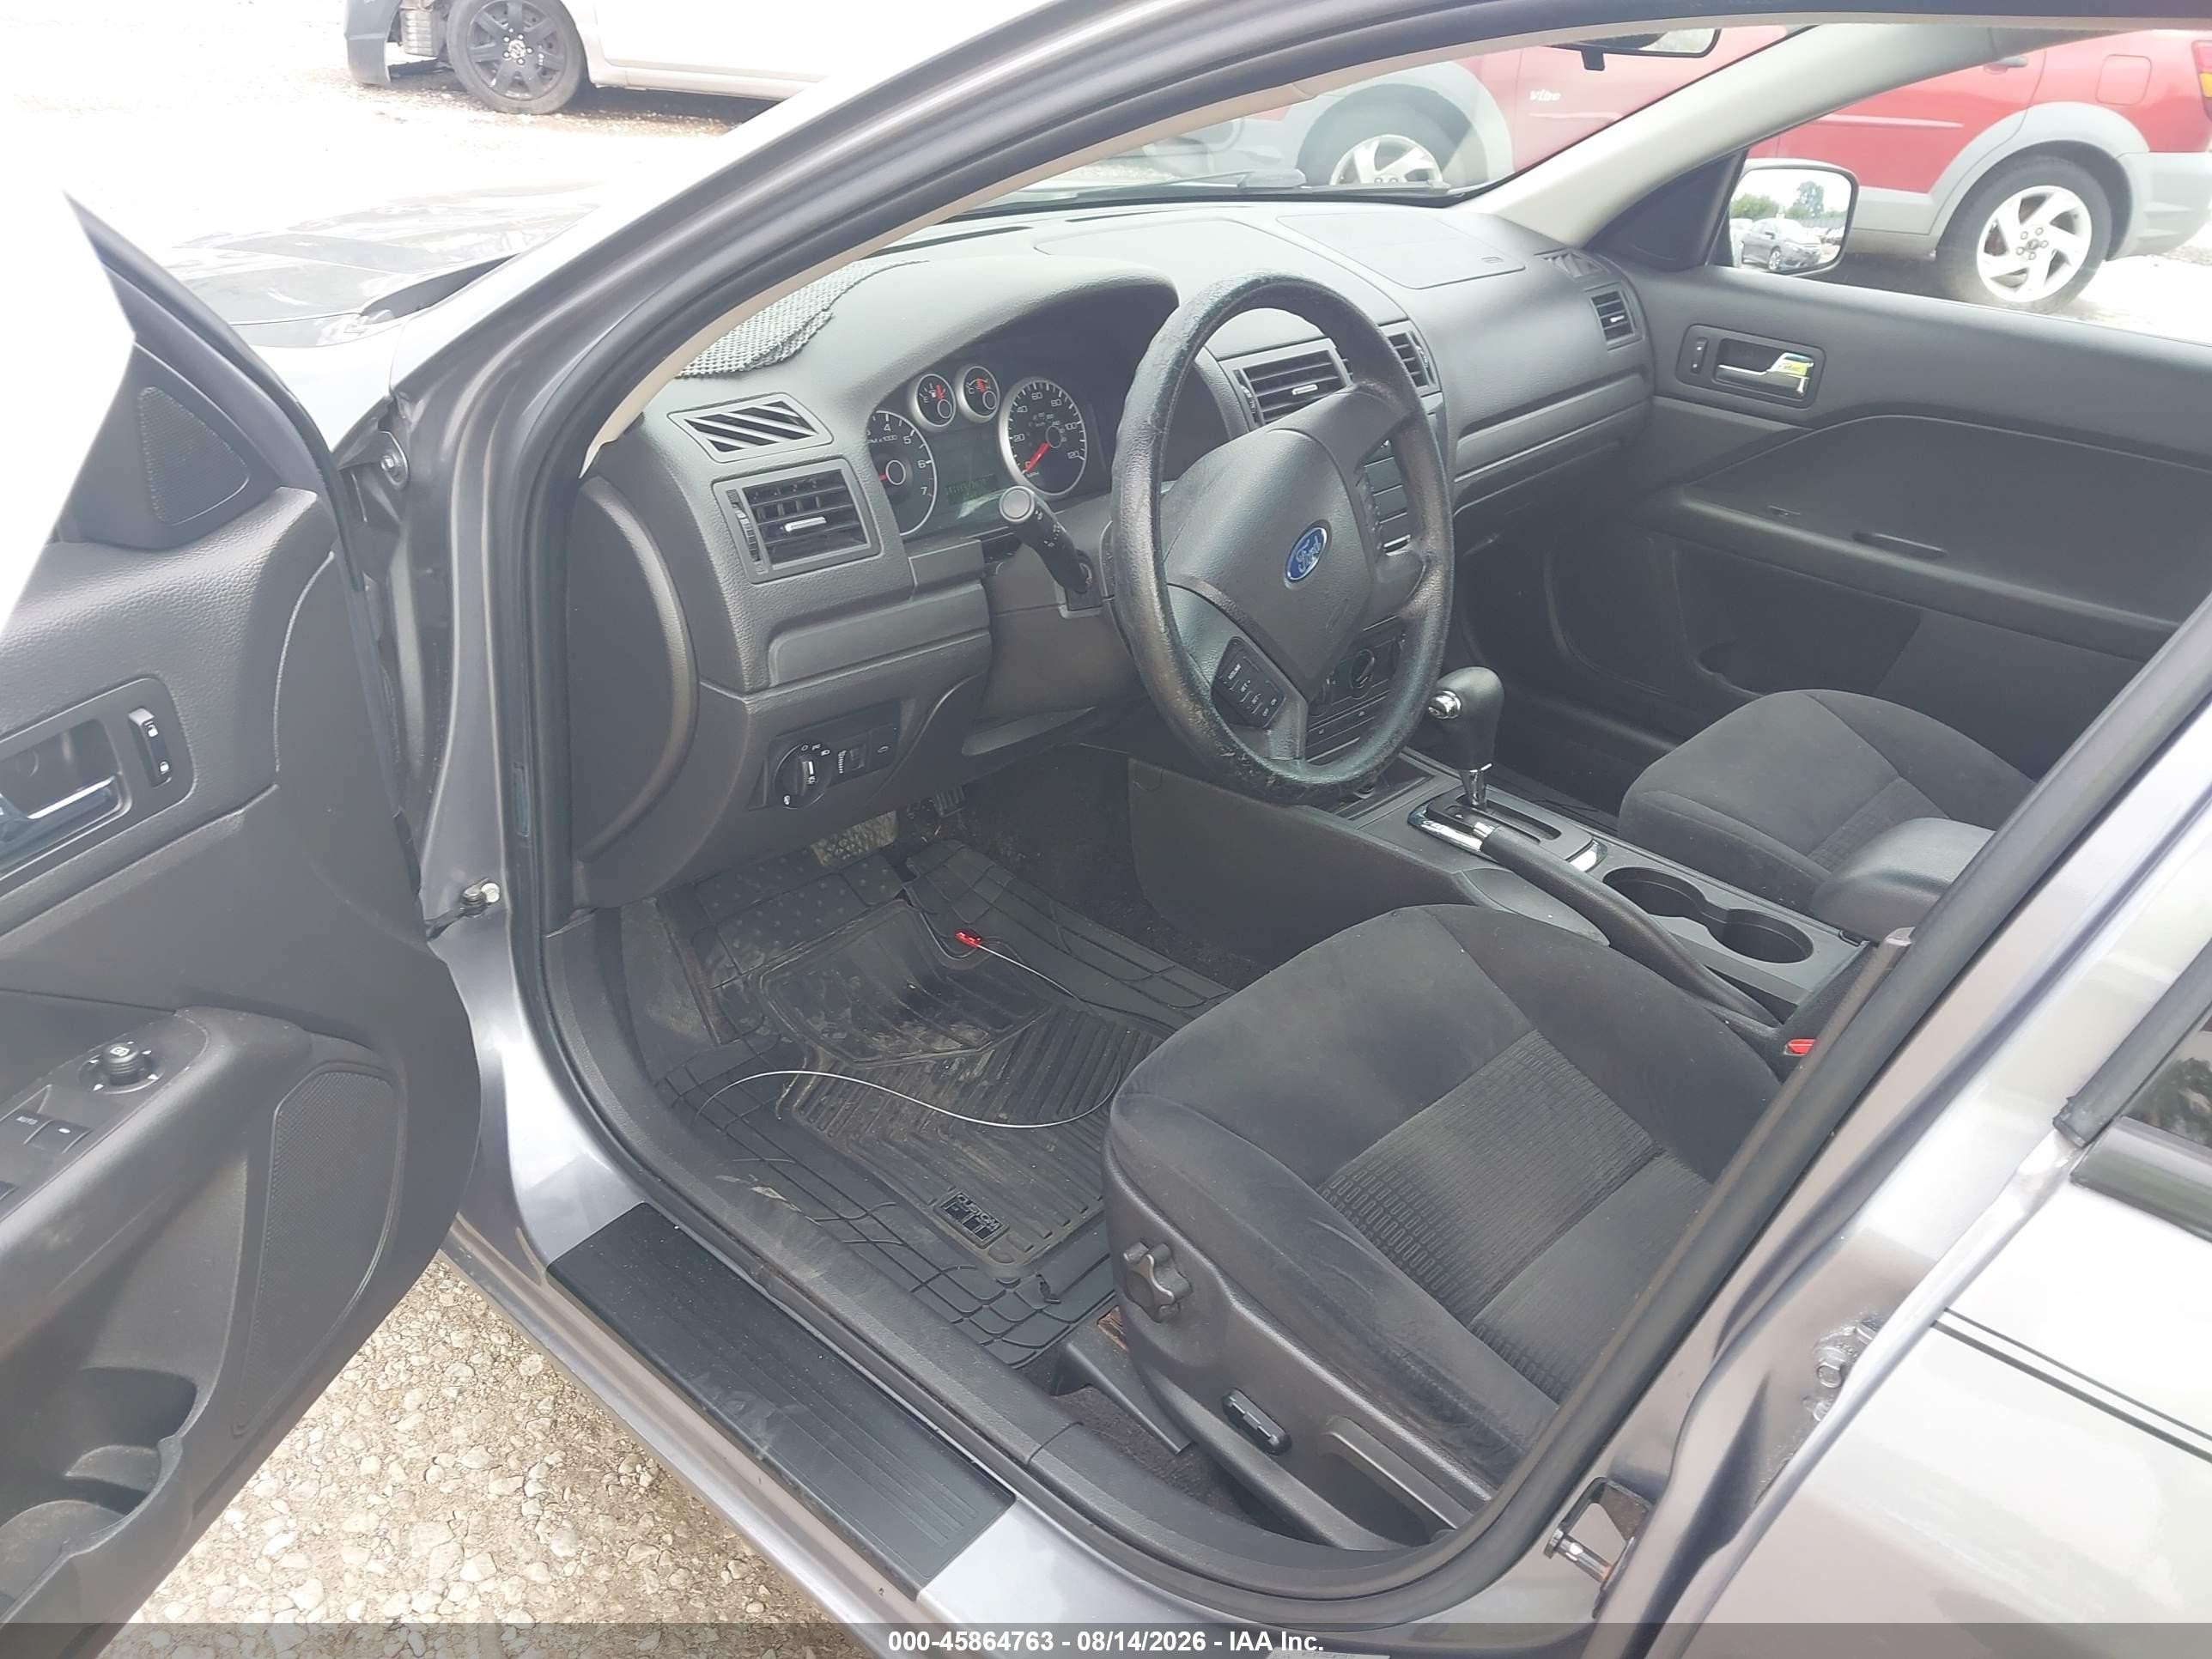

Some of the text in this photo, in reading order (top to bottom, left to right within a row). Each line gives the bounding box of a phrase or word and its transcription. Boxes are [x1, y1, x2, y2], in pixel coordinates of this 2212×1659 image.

[1031, 392, 1043, 400] 60
[883, 421, 891, 432] 4
[902, 435, 912, 445] 5
[1013, 433, 1025, 442] 20
[918, 459, 927, 469] 6
[921, 487, 928, 495] 7
[956, 1194, 1000, 1232] CUSTOM
